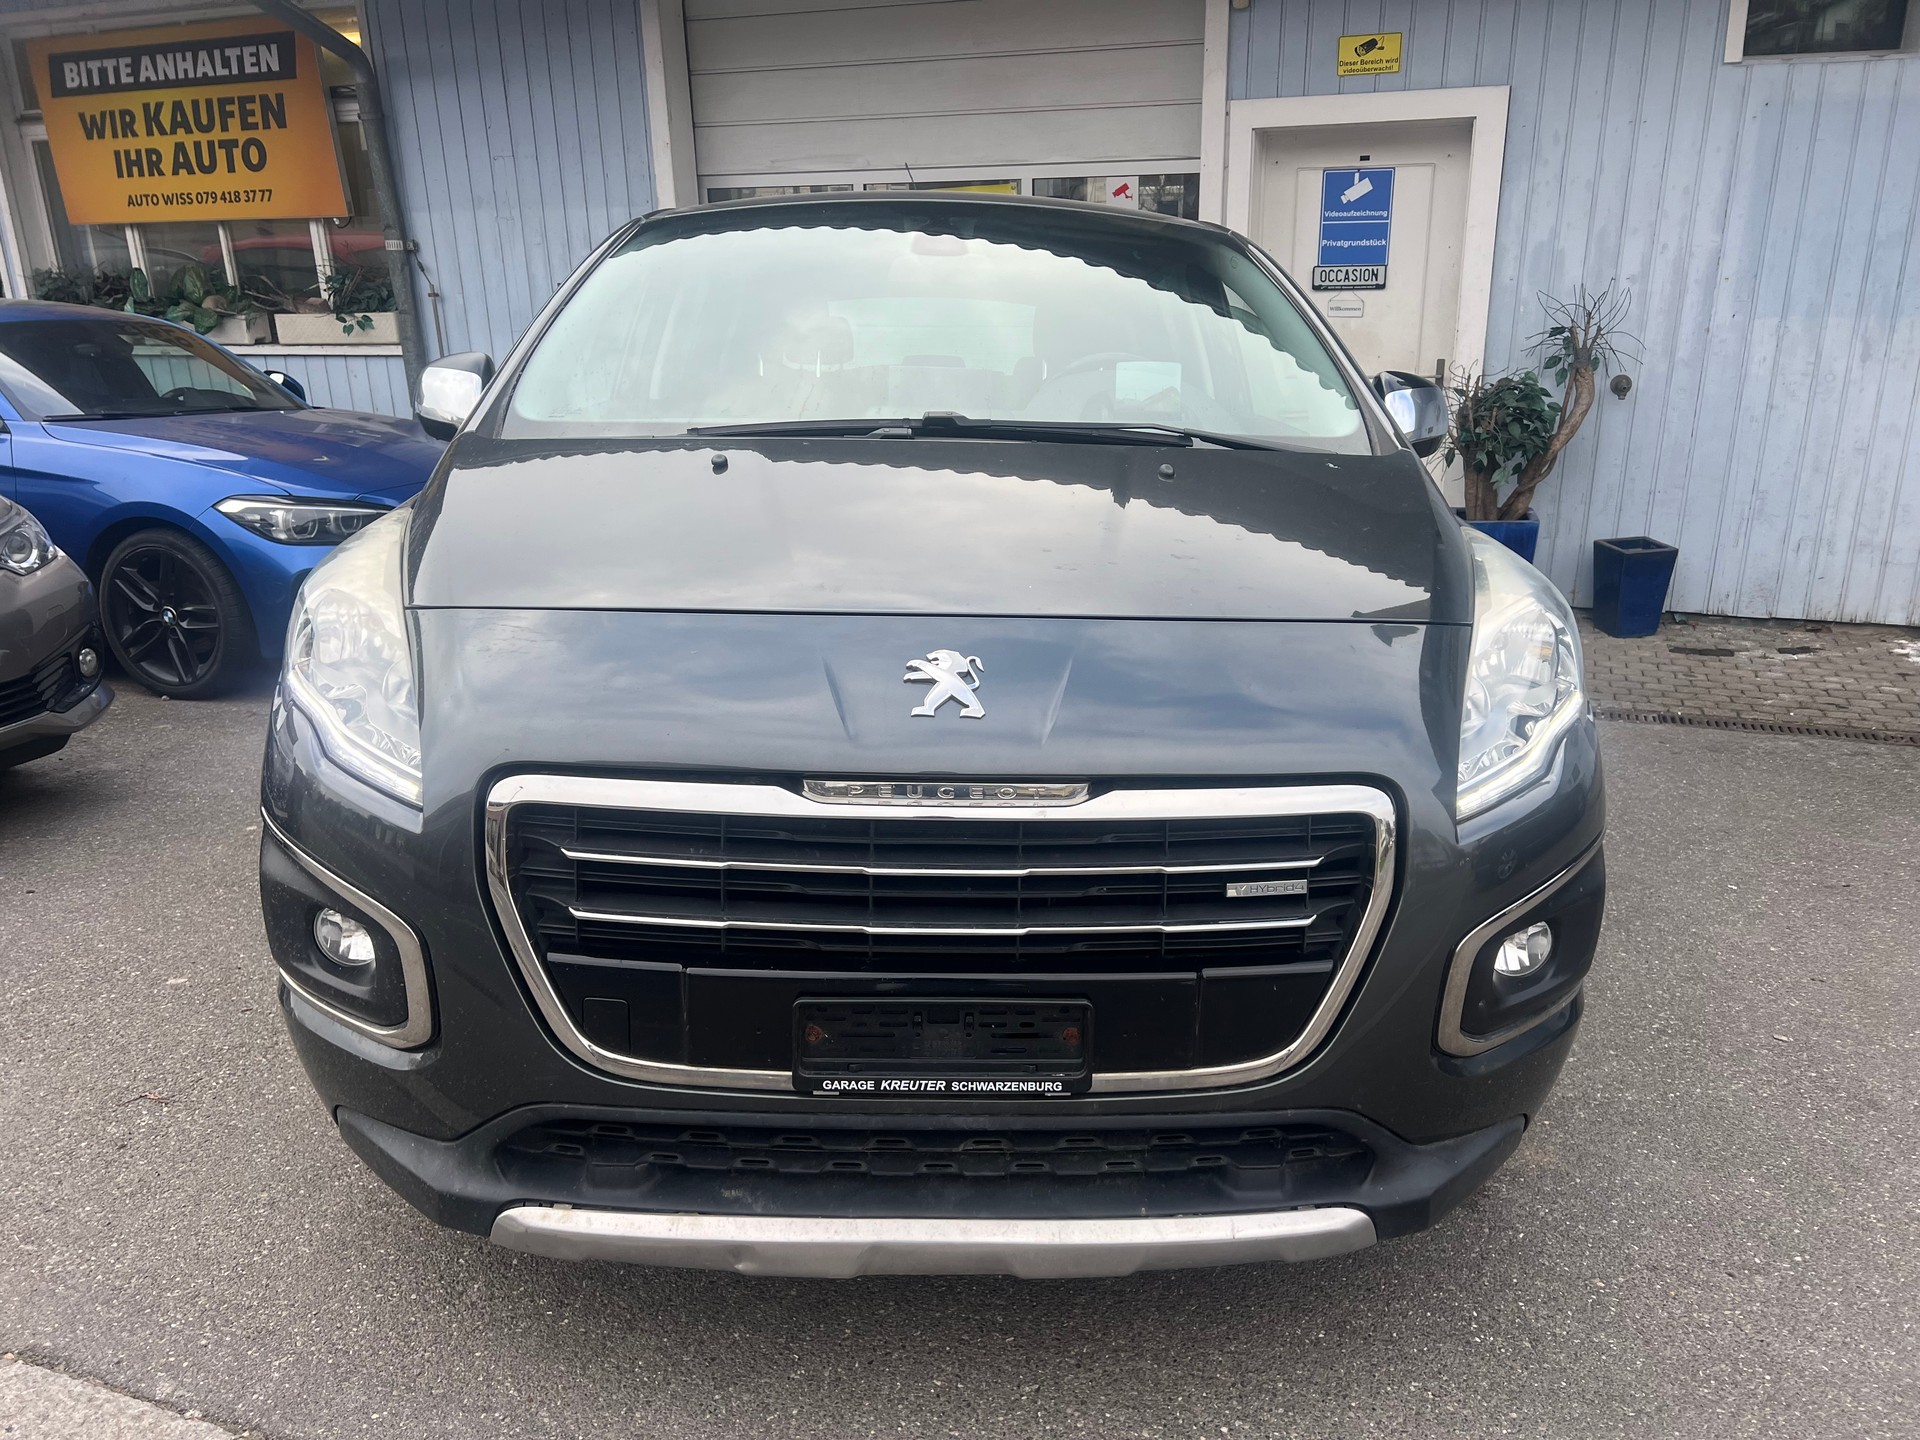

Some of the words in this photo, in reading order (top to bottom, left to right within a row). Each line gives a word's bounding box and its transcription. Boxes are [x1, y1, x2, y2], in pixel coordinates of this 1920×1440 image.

[63, 55, 135, 89] BITTE
[139, 43, 280, 83] ANHALTEN
[1343, 65, 1394, 74] videoüberwacht!
[1360, 58, 1384, 66] Bereich
[78, 108, 139, 141] WIR
[142, 92, 288, 137] KAUFEN
[113, 147, 166, 179] IHR
[171, 137, 268, 176] AUTO
[127, 193, 160, 207] AUTO
[161, 192, 194, 206] WISS
[195, 191, 218, 205] 079
[220, 190, 242, 204] 418
[243, 189, 257, 203] 37
[258, 188, 273, 202] 77
[1324, 209, 1388, 218] Videoaufzeichnung
[1322, 239, 1387, 249] Privatgrundstück
[1320, 267, 1379, 283] OCCASION
[847, 784, 1046, 799] PEUGEOT
[822, 1080, 875, 1091] GARAGE
[880, 1079, 946, 1091] KREUTER
[951, 1081, 1063, 1092] SCHWARZENBURG
